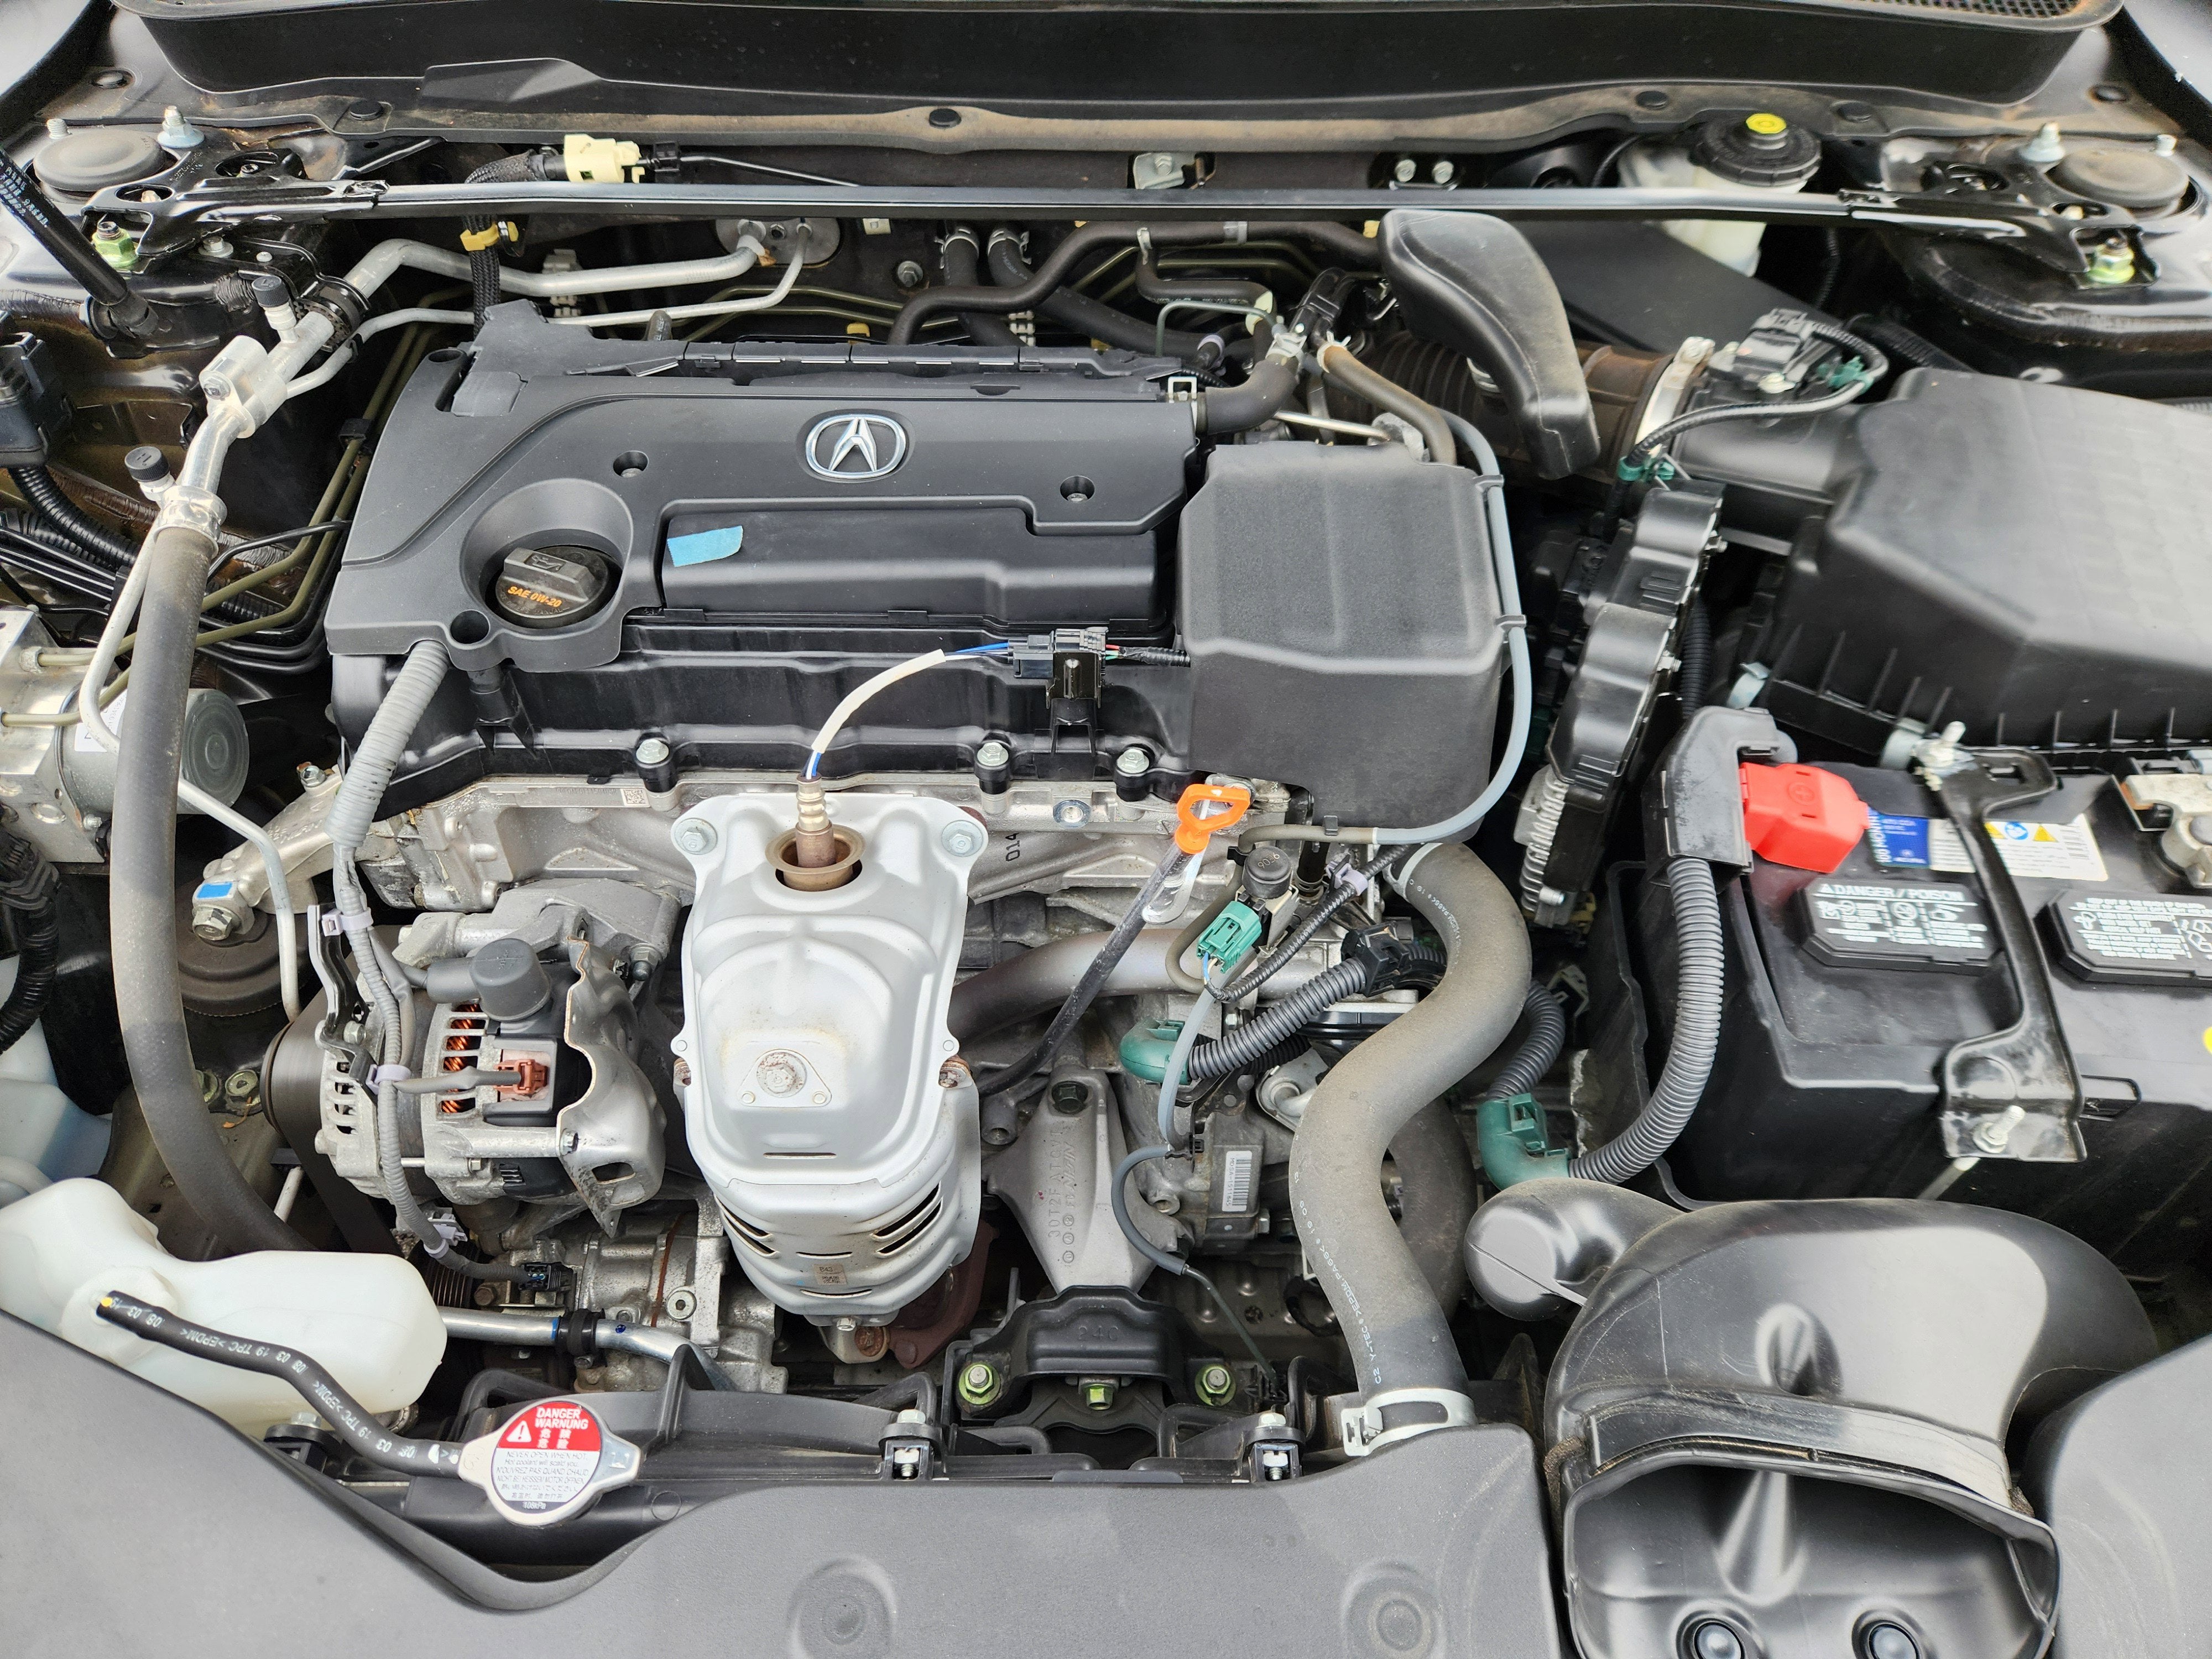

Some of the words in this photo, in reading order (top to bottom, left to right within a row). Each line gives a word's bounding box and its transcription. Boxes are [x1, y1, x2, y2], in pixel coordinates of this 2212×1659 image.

[507, 586, 531, 598] SAE
[529, 592, 562, 607] 0W-20
[1005, 832, 1020, 862] 014
[1834, 885, 1895, 897] DANGER
[1907, 889, 1965, 901] POISON
[128, 1306, 142, 1319] 03
[228, 1342, 252, 1354] TPC
[1362, 1326, 1376, 1361] Y-TEC
[255, 1346, 270, 1357] 19
[275, 1351, 291, 1363] 03
[536, 1406, 581, 1419] DANGER
[341, 1411, 360, 1431] TPC
[535, 1418, 589, 1430] WARNUNG
[359, 1427, 372, 1439] 19
[375, 1439, 392, 1453] 03
[542, 1468, 566, 1476] QUAND
